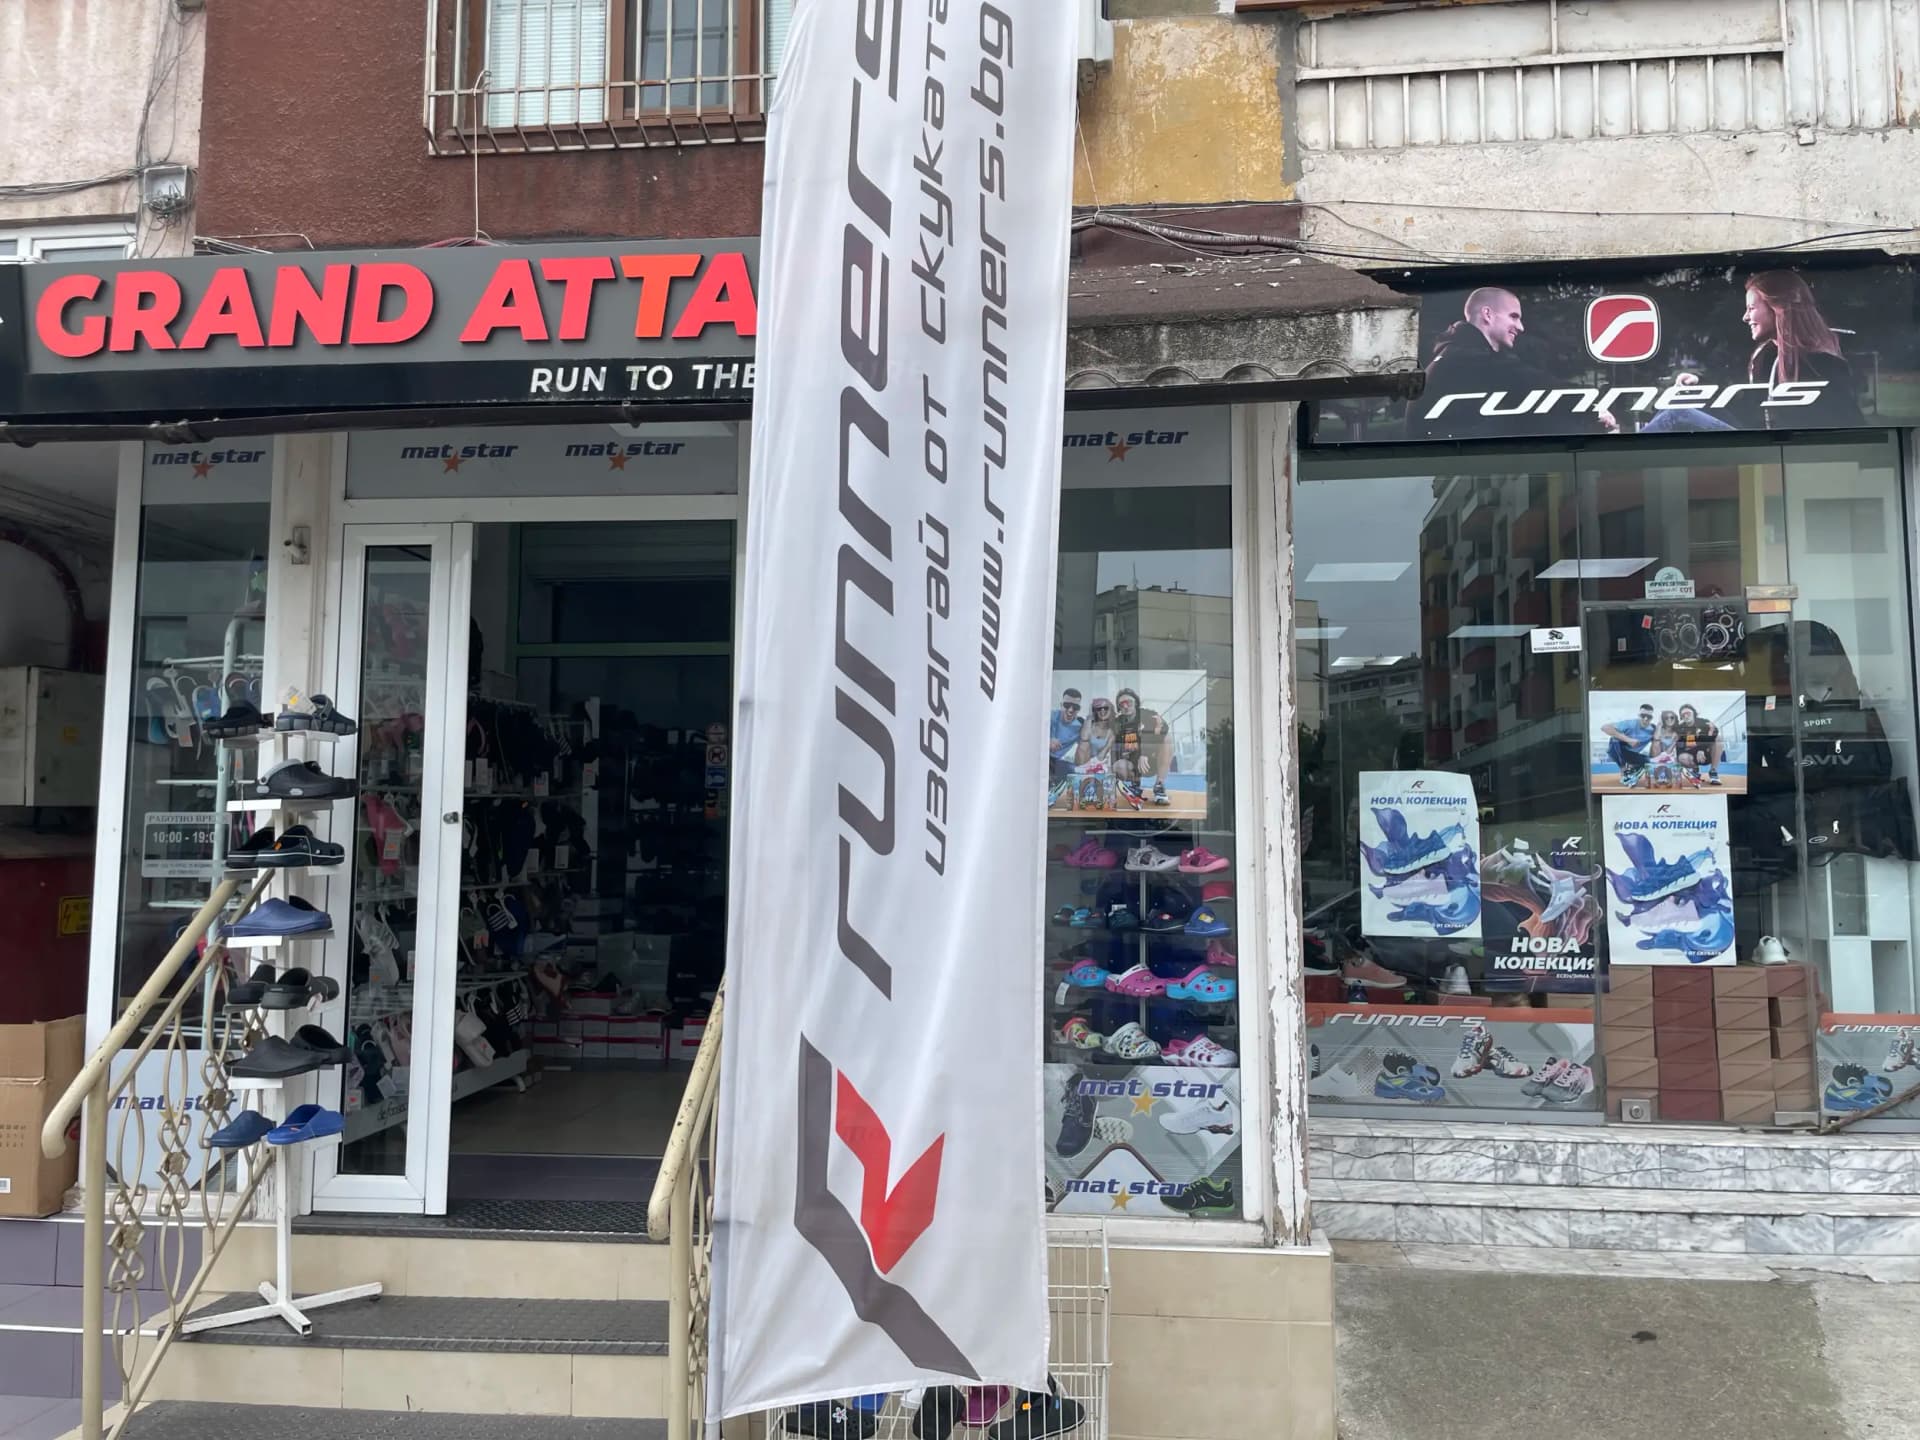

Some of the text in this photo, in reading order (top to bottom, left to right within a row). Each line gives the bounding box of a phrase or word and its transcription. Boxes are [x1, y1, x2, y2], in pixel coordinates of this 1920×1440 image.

[35, 252, 757, 358] GRAND ATTA
[970, 1, 1013, 702] www.runners.bg
[530, 363, 755, 393] RUN TO THE
[1424, 380, 1830, 419] runners
[922, 373, 949, 484] от
[1063, 429, 1189, 447] mat star
[152, 449, 266, 465] mat star
[400, 443, 519, 459] mat star
[565, 440, 685, 457] mat star
[918, 512, 950, 877] избягай
[1803, 717, 1833, 728] SPORT
[1370, 797, 1468, 806] НОВА КОЛЕКЦИЯ
[1614, 820, 1718, 831] НОВА КОЛЕКЦИЯ
[152, 831, 182, 843] 10:00
[192, 831, 216, 843] 19:0
[1511, 936, 1581, 953] НОВА
[1494, 956, 1599, 972] КОЛЕКЦИЯ
[1330, 1012, 1486, 1028] runners
[1078, 1079, 1224, 1099] mat star
[176, 1094, 238, 1110] str
[1064, 1178, 1190, 1197] mat star
